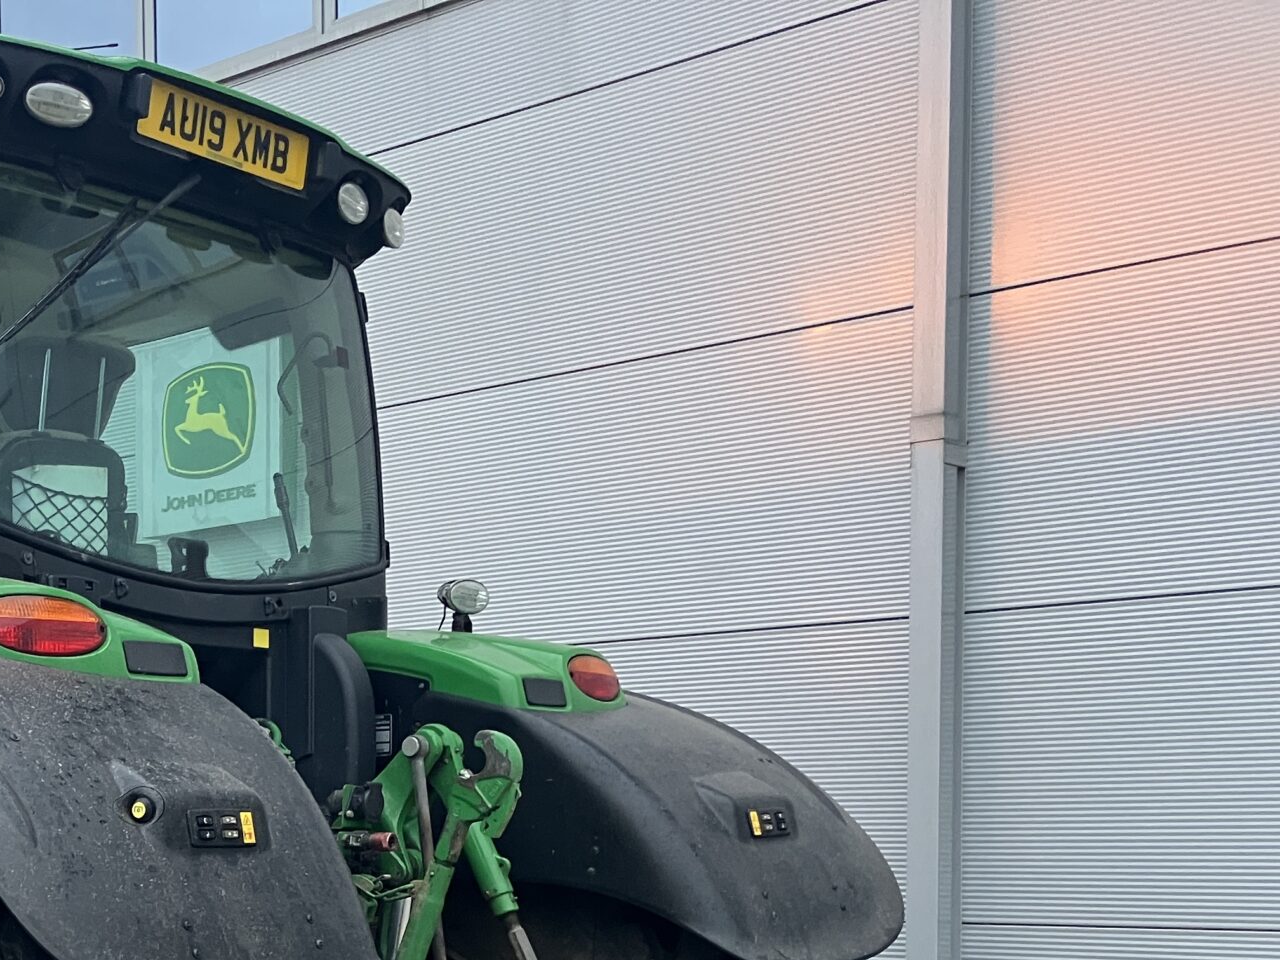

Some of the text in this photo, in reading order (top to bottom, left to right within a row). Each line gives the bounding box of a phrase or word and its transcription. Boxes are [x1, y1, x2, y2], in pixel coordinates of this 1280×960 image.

[159, 92, 290, 175] AU19 XMB
[160, 483, 256, 513] JOHN DEERE
